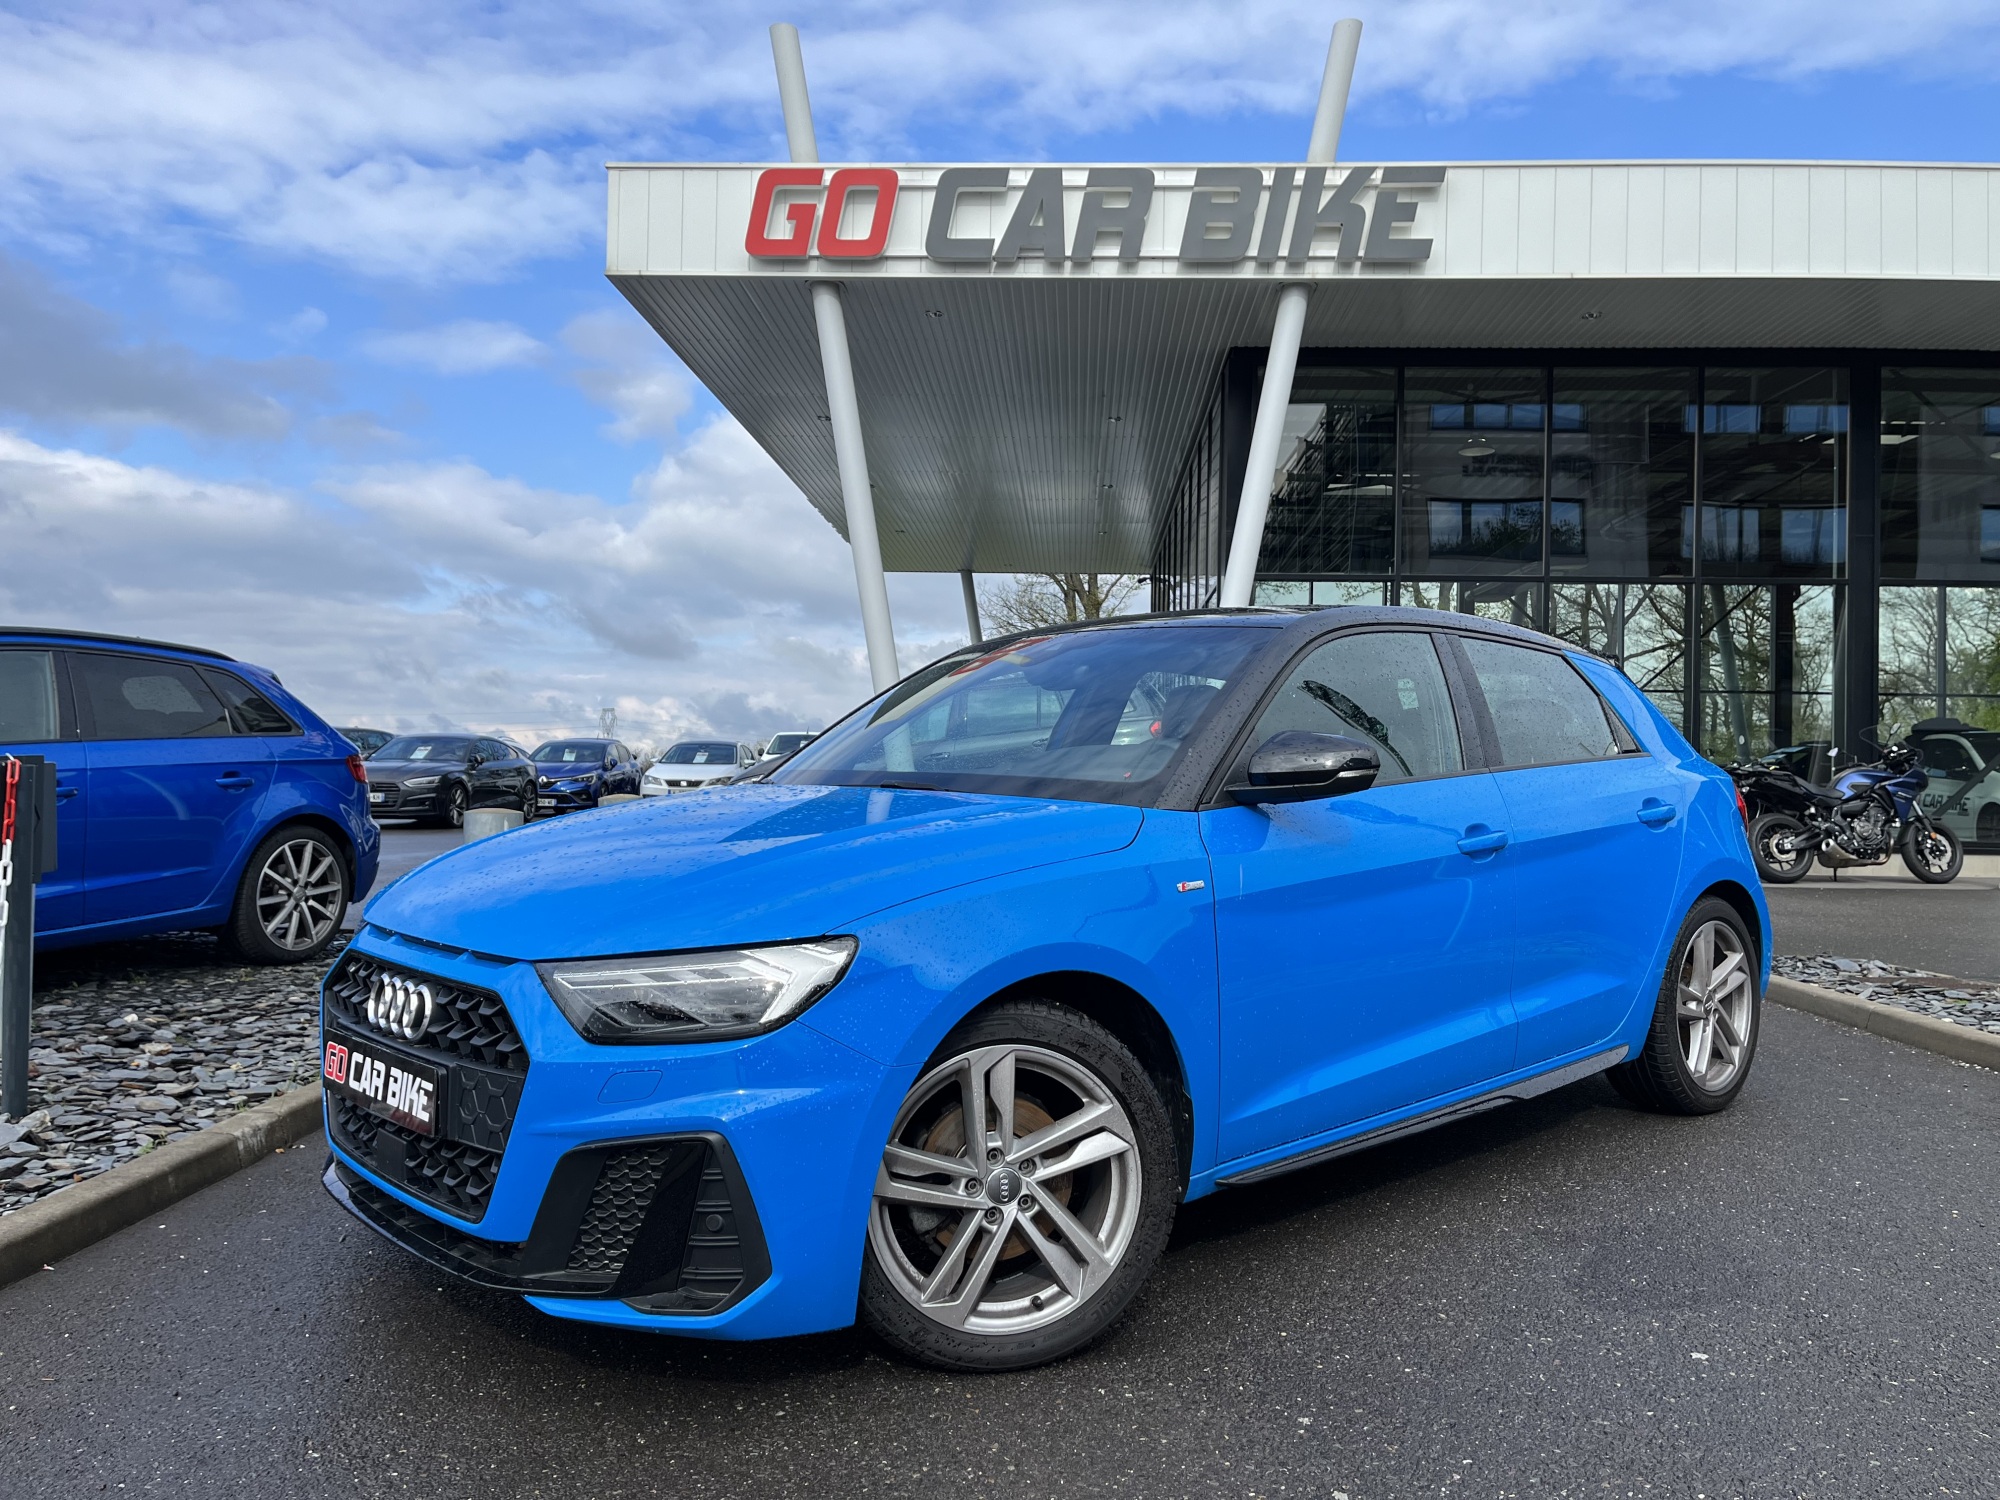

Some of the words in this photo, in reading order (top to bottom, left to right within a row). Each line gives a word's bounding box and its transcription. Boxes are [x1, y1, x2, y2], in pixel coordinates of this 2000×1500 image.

[745, 168, 899, 260] GO
[925, 168, 1156, 262] CAR
[1178, 166, 1446, 262] BIKE
[324, 1041, 348, 1084] GO
[349, 1052, 386, 1101] CAR
[387, 1067, 433, 1122] BIKE
